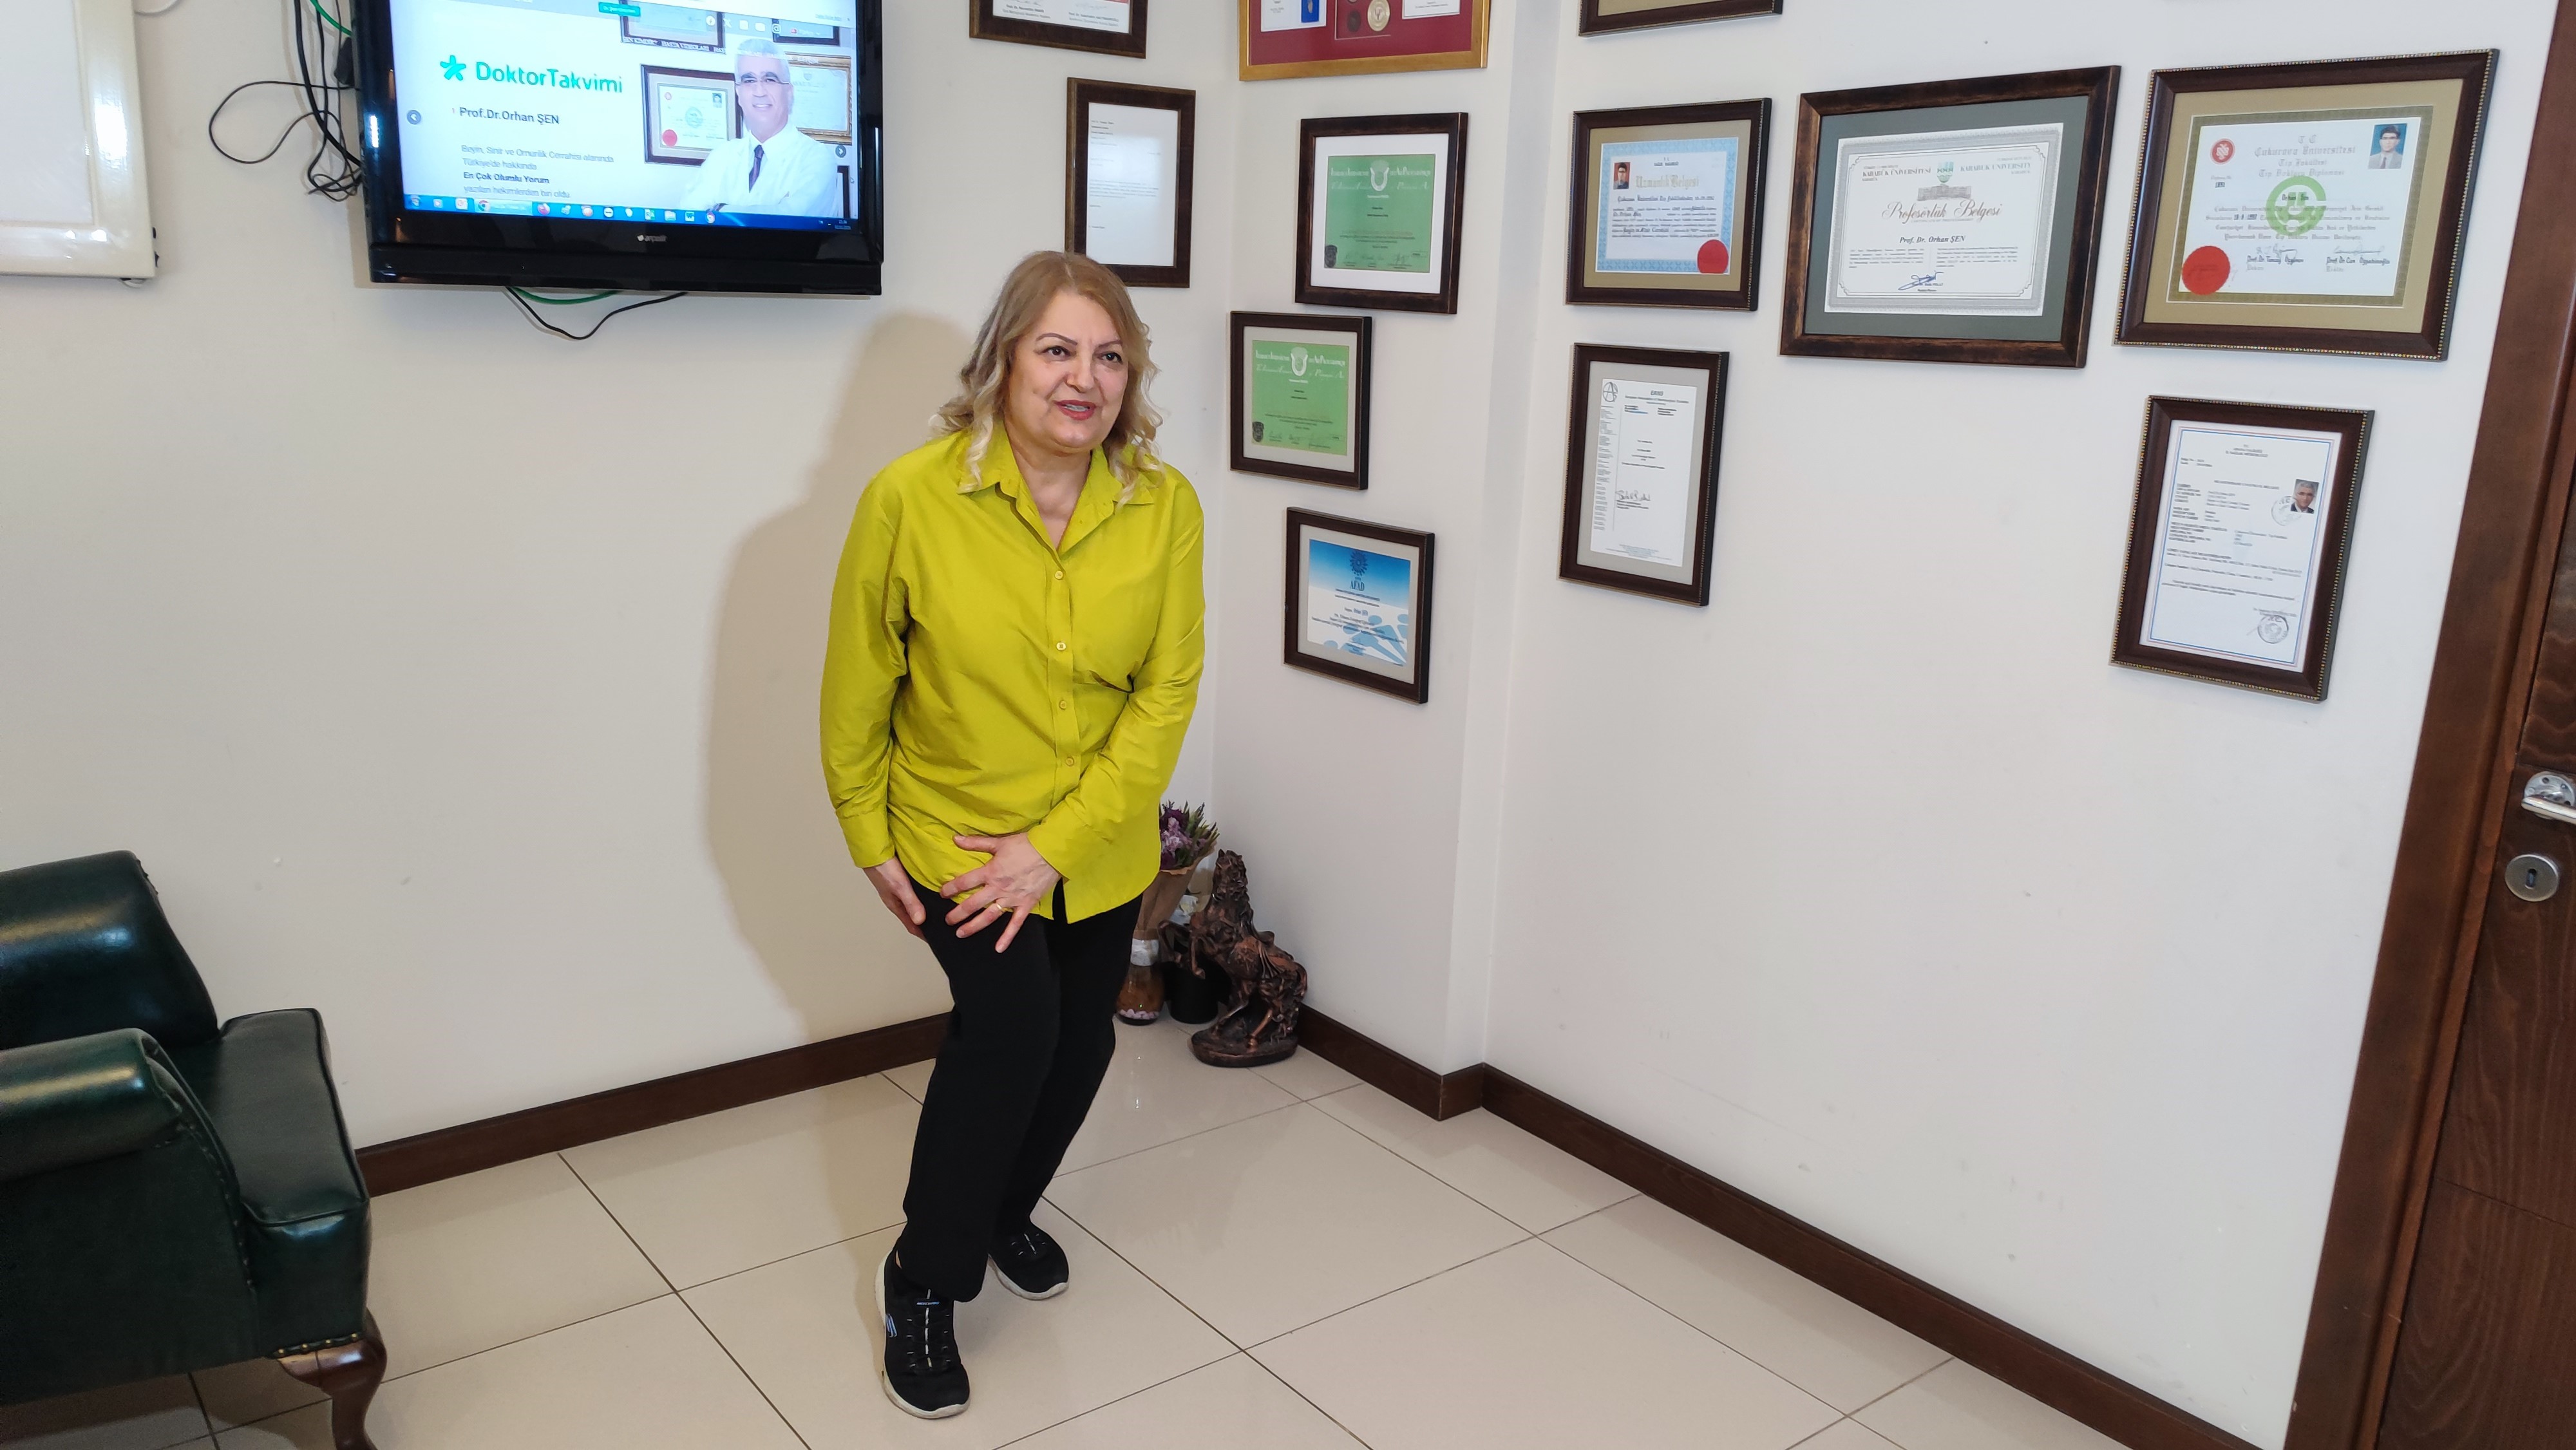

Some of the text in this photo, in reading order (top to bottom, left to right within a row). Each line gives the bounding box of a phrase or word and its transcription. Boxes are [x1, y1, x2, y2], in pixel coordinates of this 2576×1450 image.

[476, 61, 623, 93] DoktorTakvimi
[459, 107, 560, 125] Prof.Dr.Orhan ŞEN
[476, 172, 491, 181] Çok
[494, 174, 522, 182] Olumlu
[523, 175, 549, 184] Yorum
[1882, 199, 2003, 225] Profesörlük Belgesi
